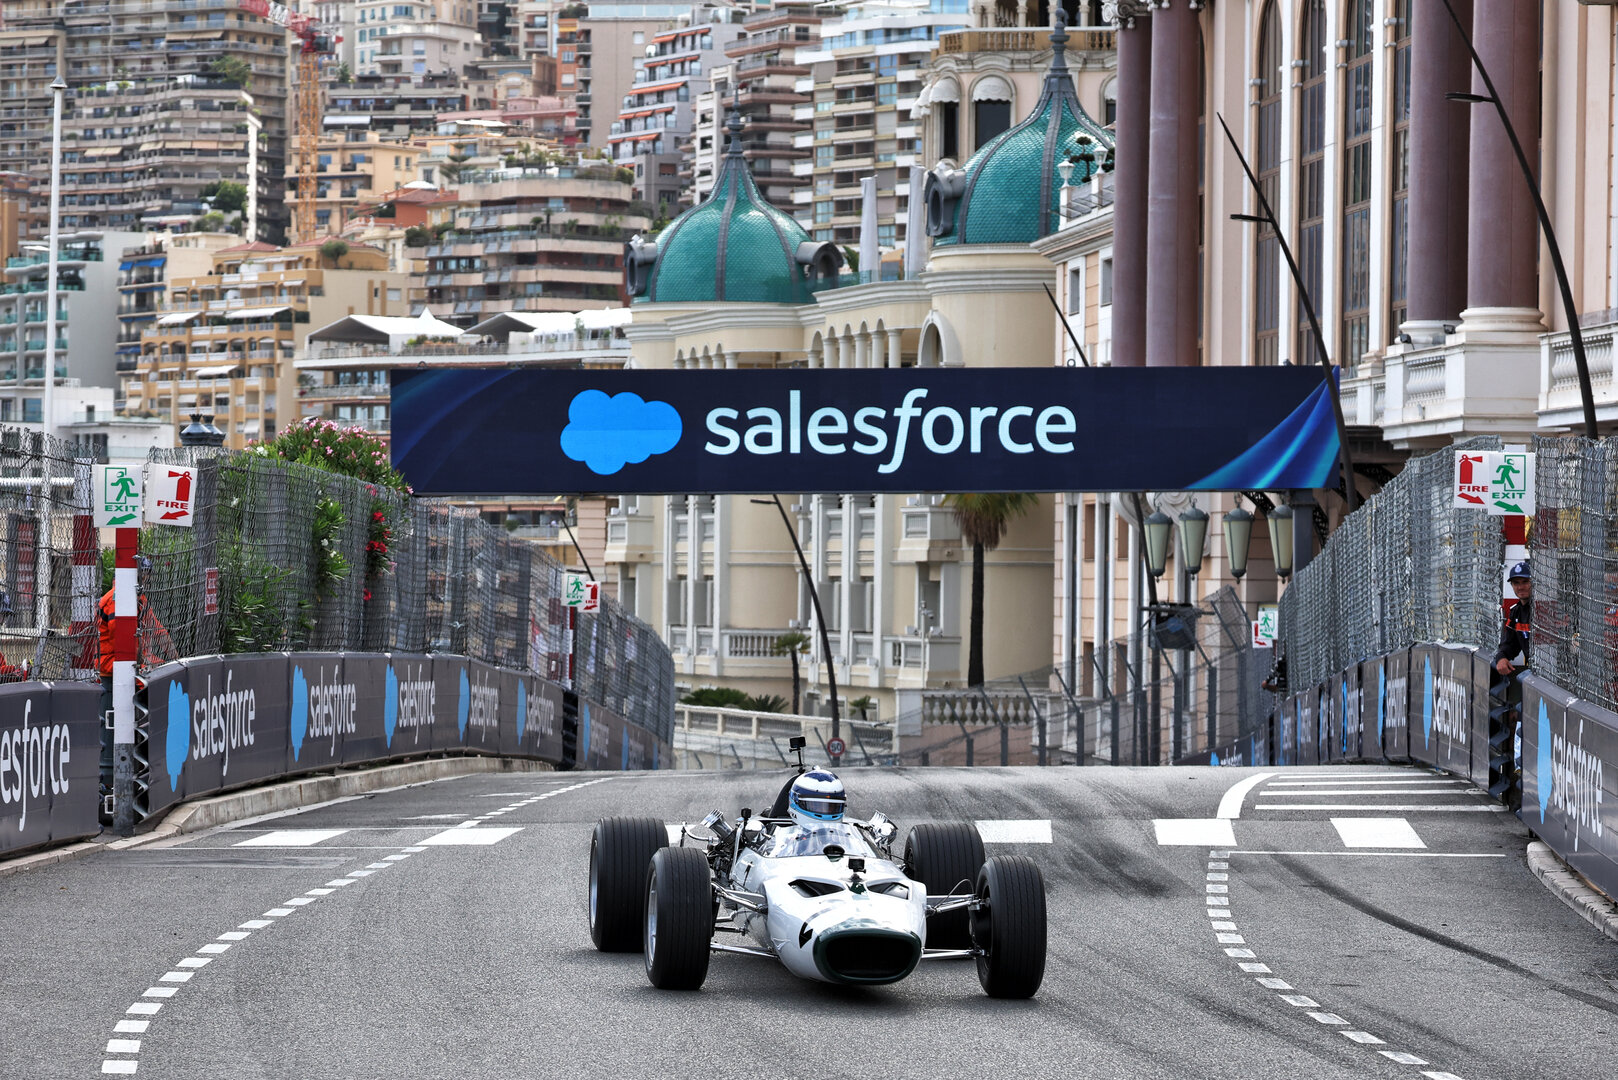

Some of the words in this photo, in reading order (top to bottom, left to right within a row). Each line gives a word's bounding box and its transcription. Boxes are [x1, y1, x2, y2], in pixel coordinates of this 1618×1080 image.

[705, 388, 1076, 473] salesforce
[157, 500, 189, 510] FIRE
[193, 669, 256, 776] salesforce
[309, 664, 357, 757] salesforce
[399, 664, 436, 745] salesforce
[1433, 657, 1467, 760] salesforce
[1553, 711, 1603, 852] salesforce
